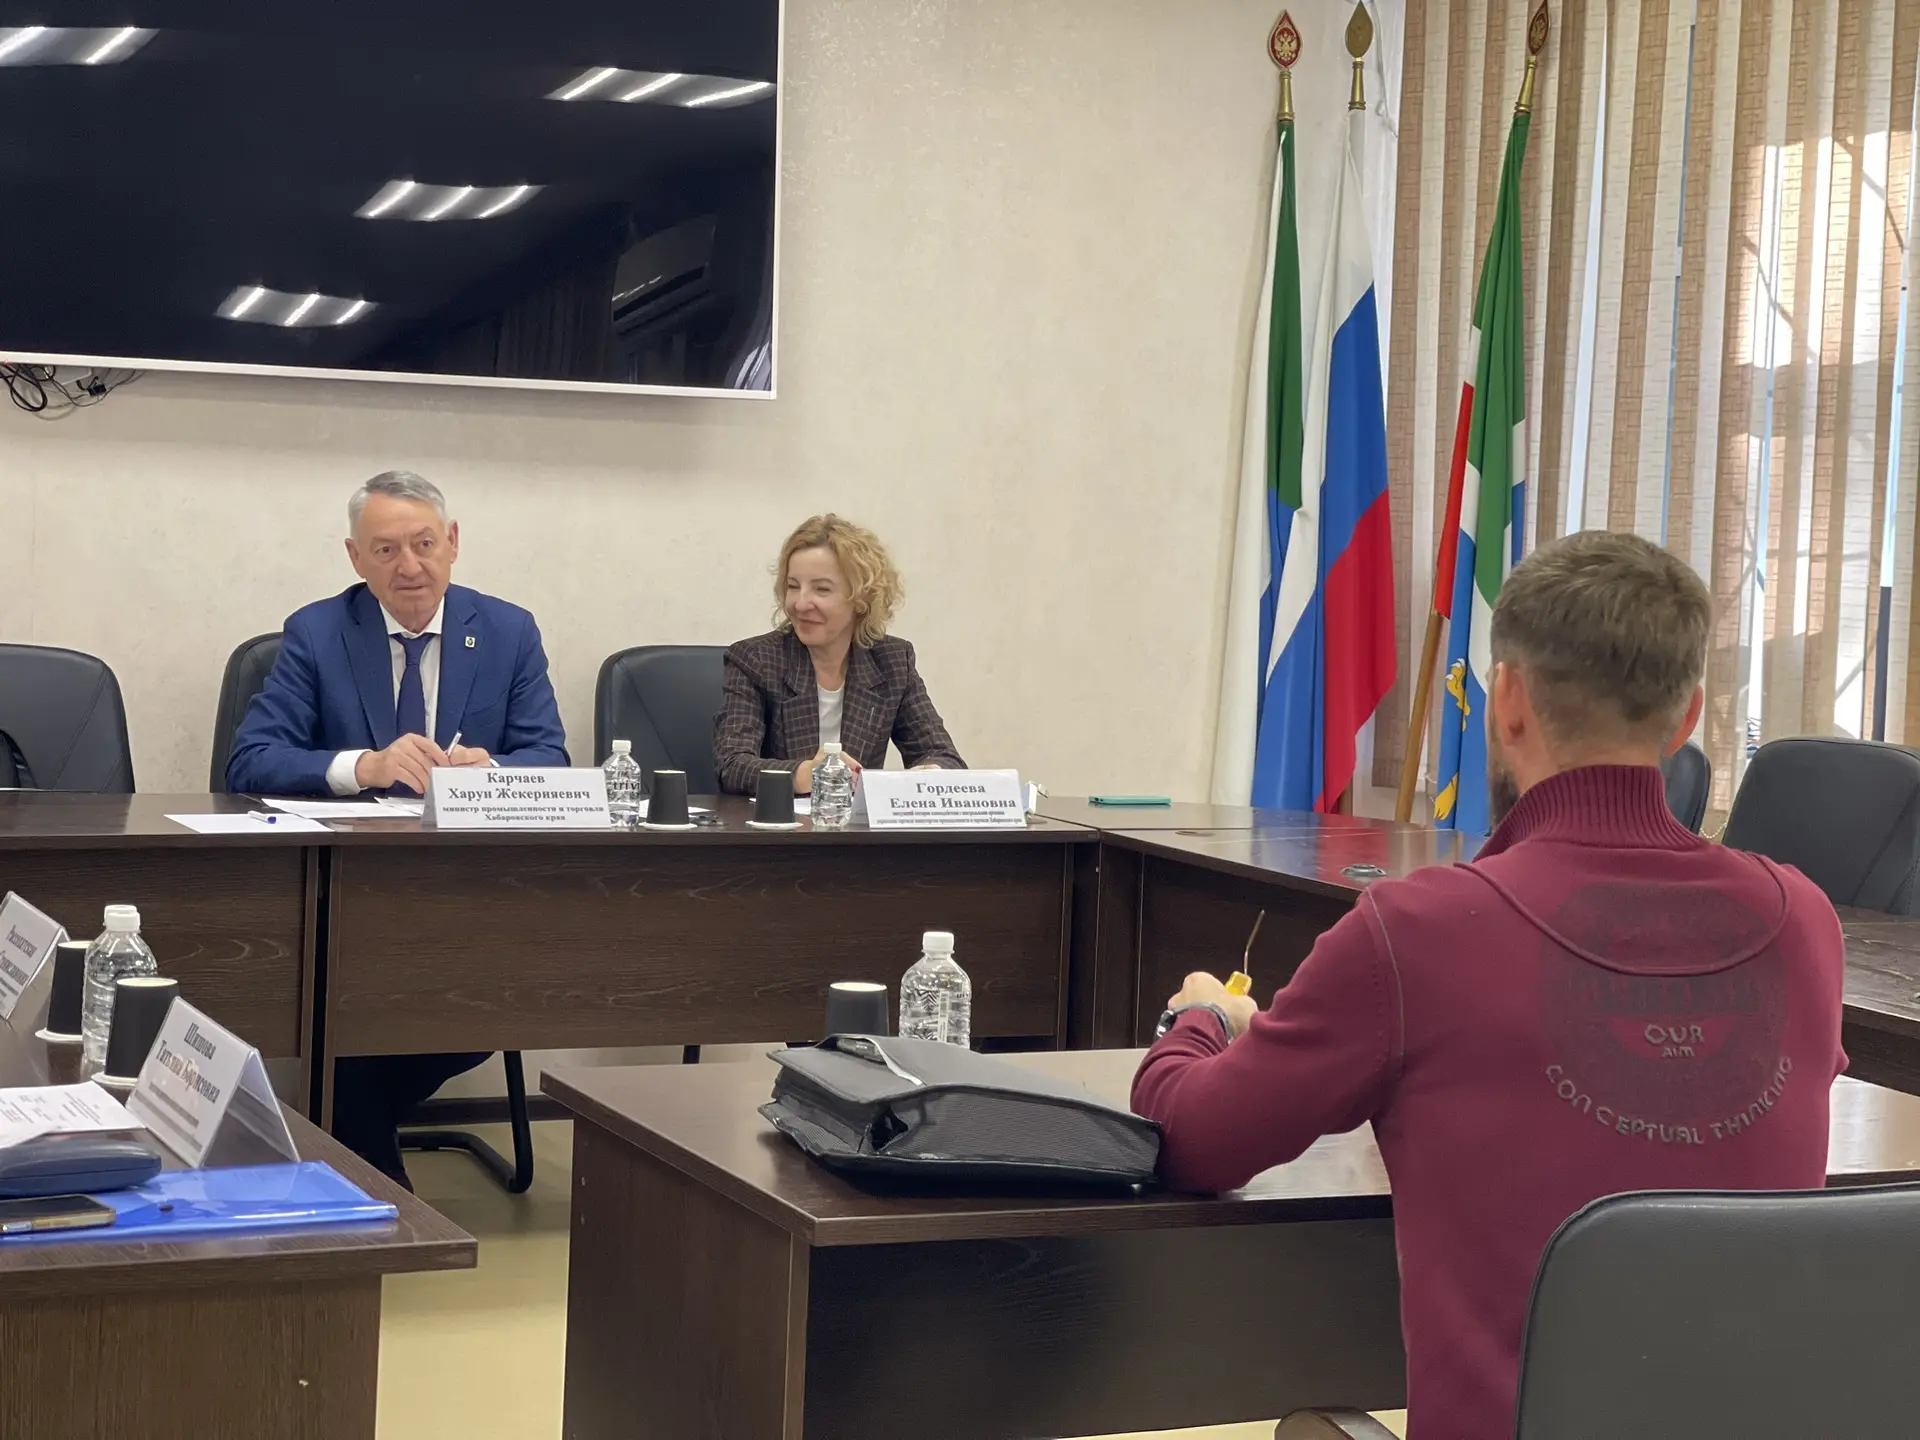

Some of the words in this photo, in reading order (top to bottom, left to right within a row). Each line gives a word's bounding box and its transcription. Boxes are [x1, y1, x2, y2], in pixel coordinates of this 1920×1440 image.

[487, 772, 545, 786] Карчаев
[448, 788, 492, 801] Харун
[496, 788, 590, 801] Жекерияевич
[916, 782, 985, 797] Гордеева
[890, 797, 937, 809] Елена
[941, 797, 1016, 809] Ивановна
[484, 813, 544, 822] Хабаровского
[1643, 1023, 1705, 1045] OUR
[155, 1040, 184, 1077] Татьяна
[182, 1057, 221, 1105] Борисовна
